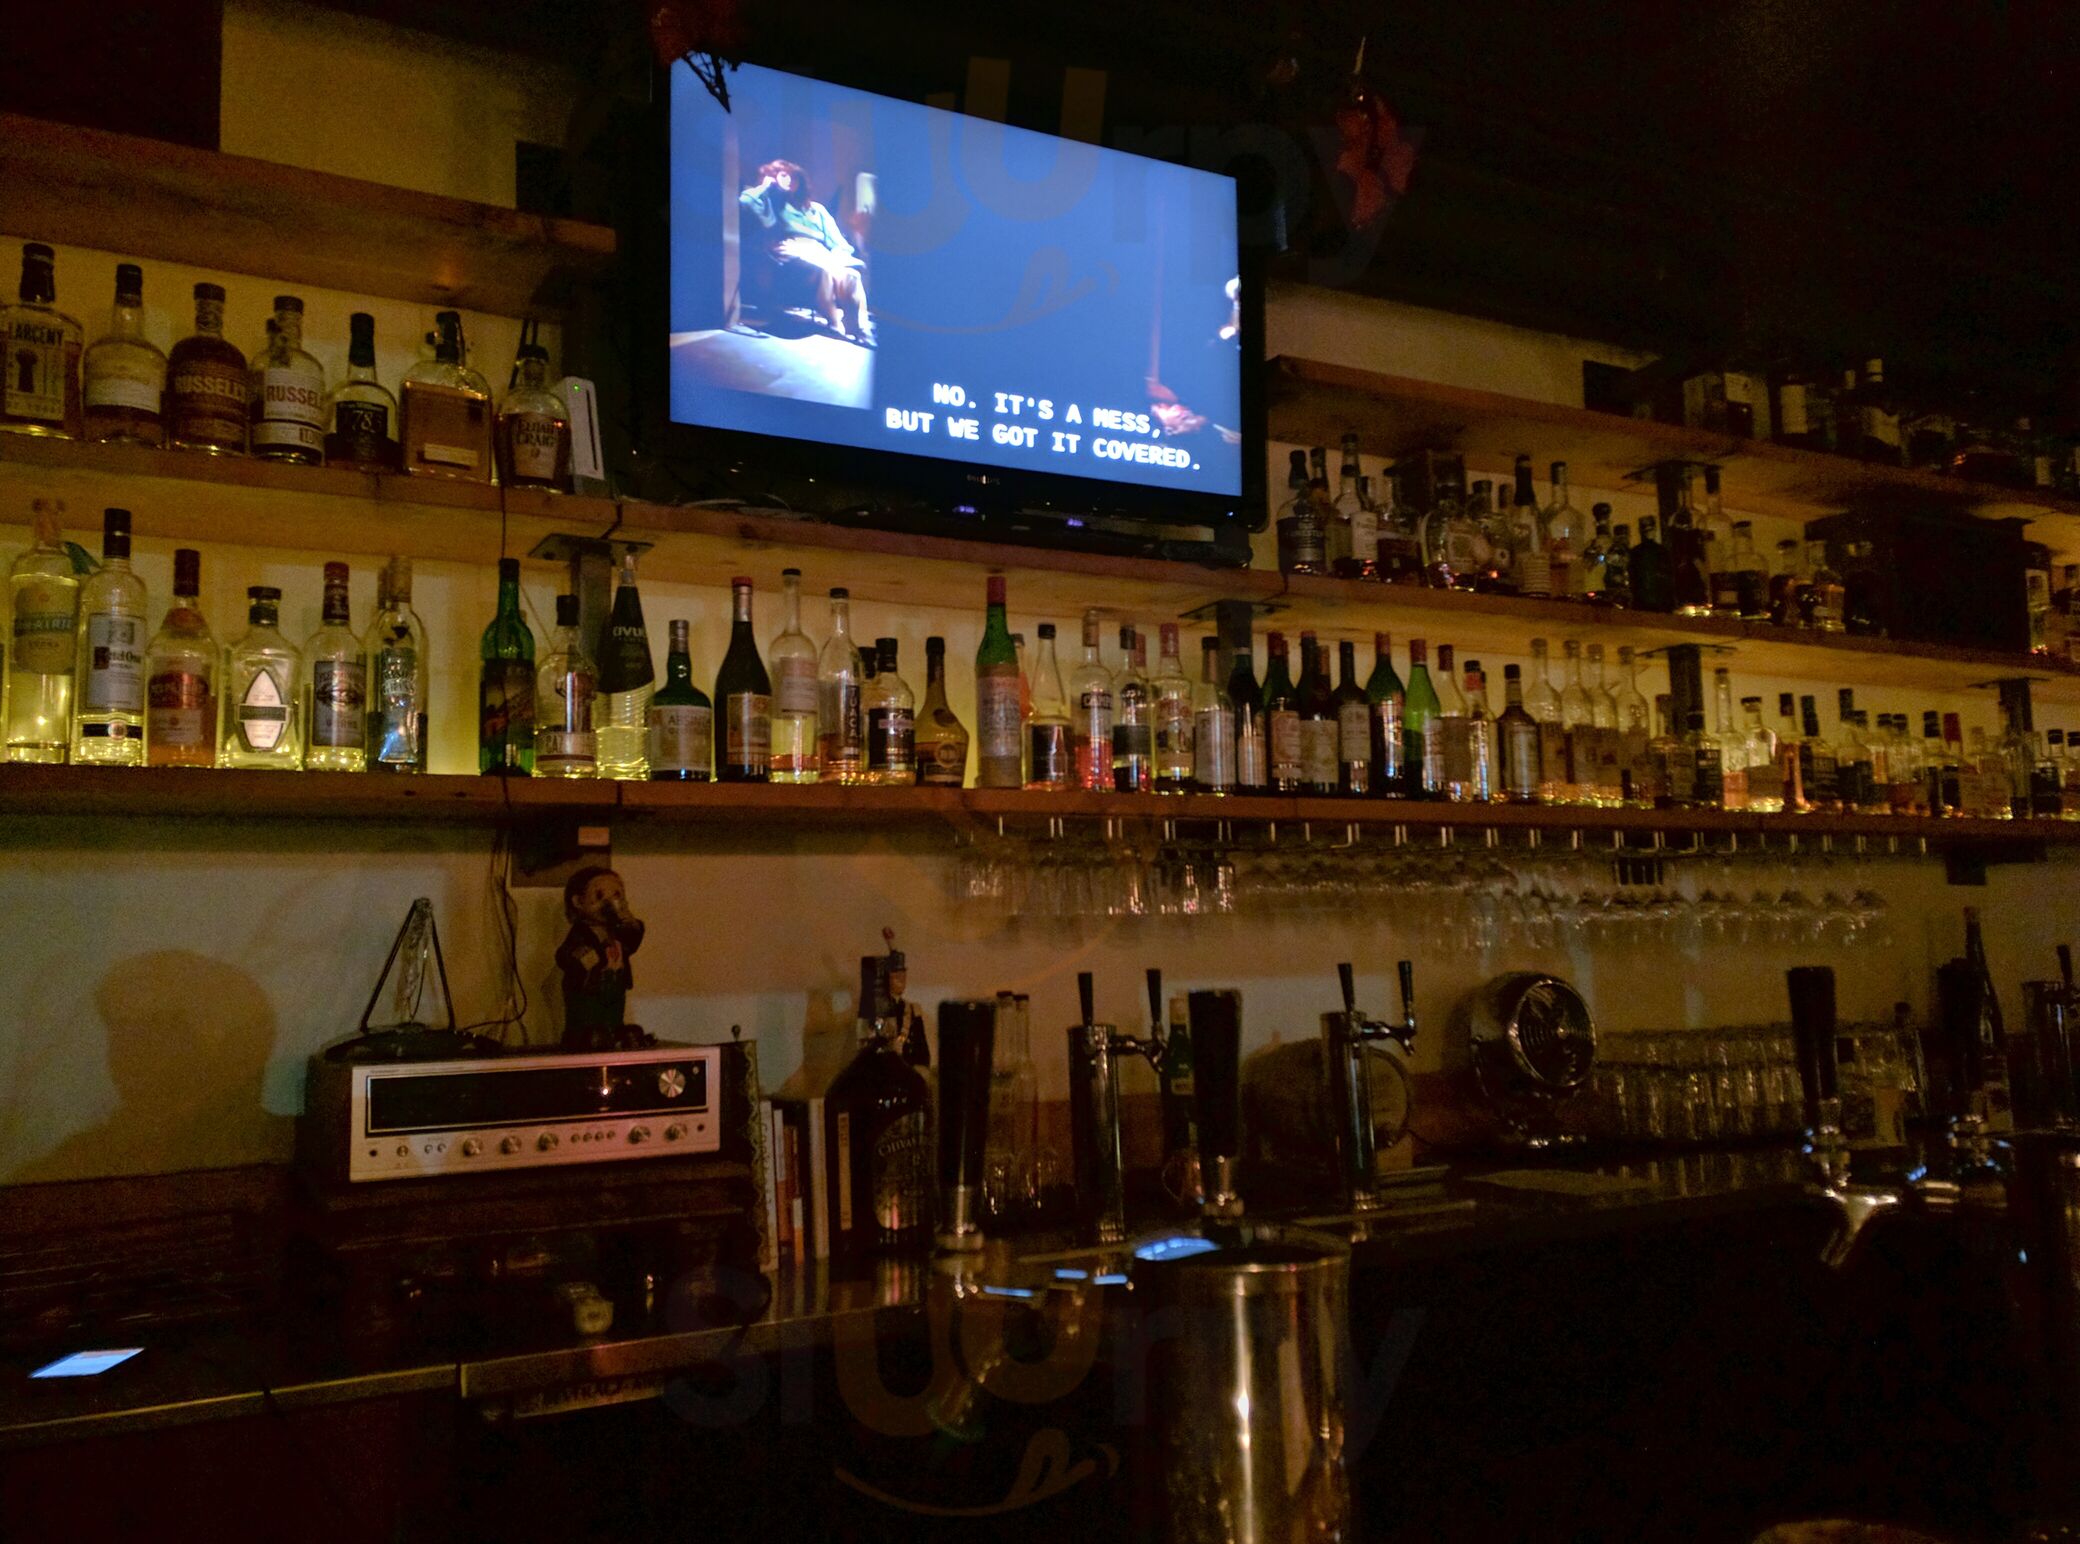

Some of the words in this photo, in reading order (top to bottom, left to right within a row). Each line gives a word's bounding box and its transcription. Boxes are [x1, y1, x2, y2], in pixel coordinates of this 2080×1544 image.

[8, 320, 64, 347] LARCENY
[932, 382, 978, 409] NO.
[993, 392, 1054, 421] IT'S
[1065, 404, 1083, 425] A
[1092, 407, 1162, 439] MESS,
[516, 426, 557, 447] CRAIG
[885, 407, 935, 433] BUT
[947, 416, 980, 441] WE
[992, 423, 1039, 449] GOT
[1051, 432, 1081, 454] IT
[1092, 439, 1202, 471] COVERED.
